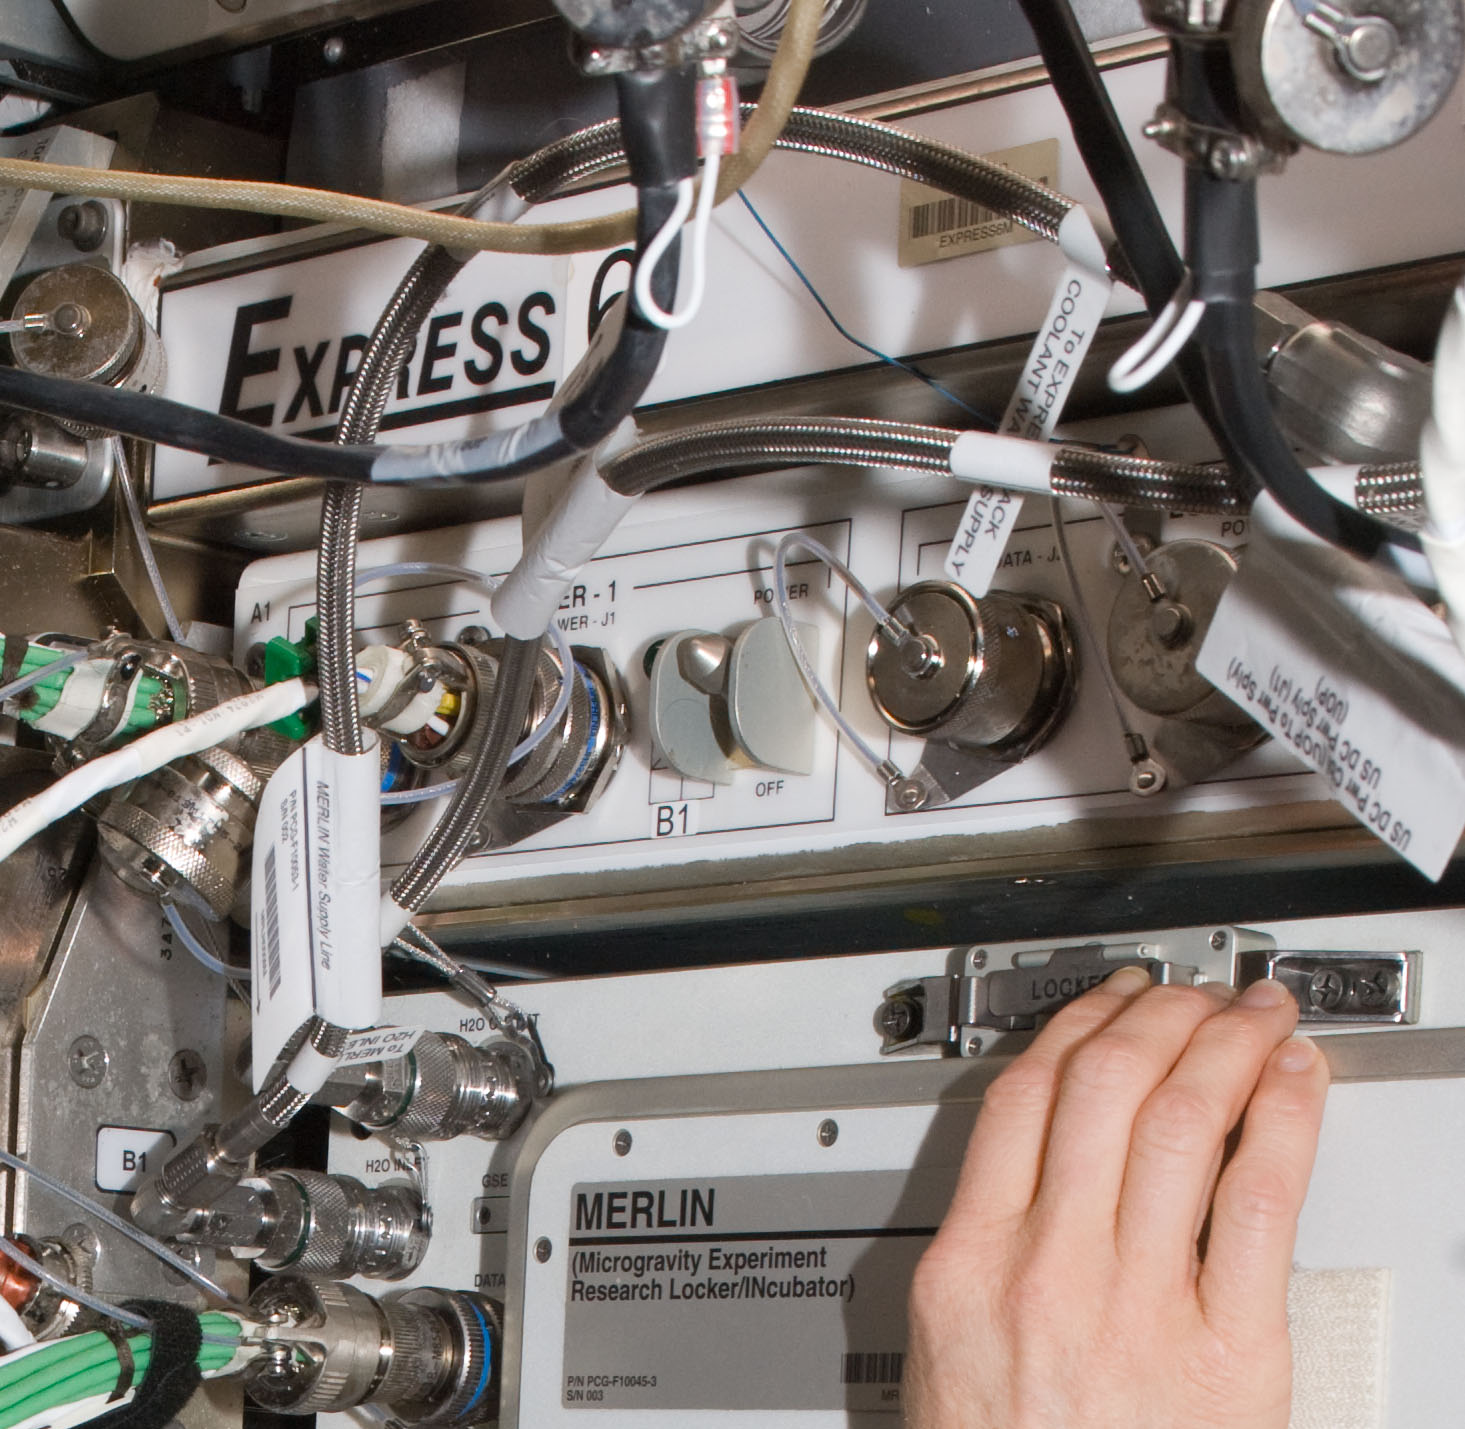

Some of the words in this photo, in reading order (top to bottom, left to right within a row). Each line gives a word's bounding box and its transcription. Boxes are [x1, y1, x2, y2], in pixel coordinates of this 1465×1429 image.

[1026, 279, 1082, 392] COOLANT
[1062, 329, 1085, 355] To
[1027, 359, 1070, 442] EXPRE
[1005, 396, 1034, 438] WA
[983, 489, 1015, 541] ACK
[250, 601, 271, 625] A1
[557, 614, 589, 632] WER
[600, 611, 616, 627] J1
[1338, 739, 1361, 772] DC
[755, 779, 785, 798] OFF
[1358, 758, 1383, 791] US
[316, 779, 330, 844] MERLIN
[656, 803, 689, 837] B1
[1367, 800, 1392, 833] DC
[1388, 817, 1413, 852] US
[317, 845, 332, 891] Water
[318, 889, 333, 940] Supply
[319, 942, 334, 971] Line
[383, 1029, 416, 1044] H2O
[459, 1016, 486, 1033] H2O
[346, 1036, 381, 1051] INLE
[387, 1042, 404, 1054] To
[122, 1149, 148, 1173] B1
[365, 1158, 391, 1173] H2O
[481, 1173, 509, 1188] GSE
[574, 1187, 716, 1231] MERLIN
[571, 1250, 703, 1279] (Microgravity
[708, 1246, 827, 1275] Experiment
[473, 1272, 506, 1288] DATA
[570, 1277, 663, 1302] Research
[669, 1273, 856, 1303] Locker/INcubator)
[566, 1390, 584, 1402] S/N
[586, 1389, 604, 1402] 003
[567, 1375, 585, 1388] P/N
[586, 1374, 657, 1388] PCG-F10045-3
